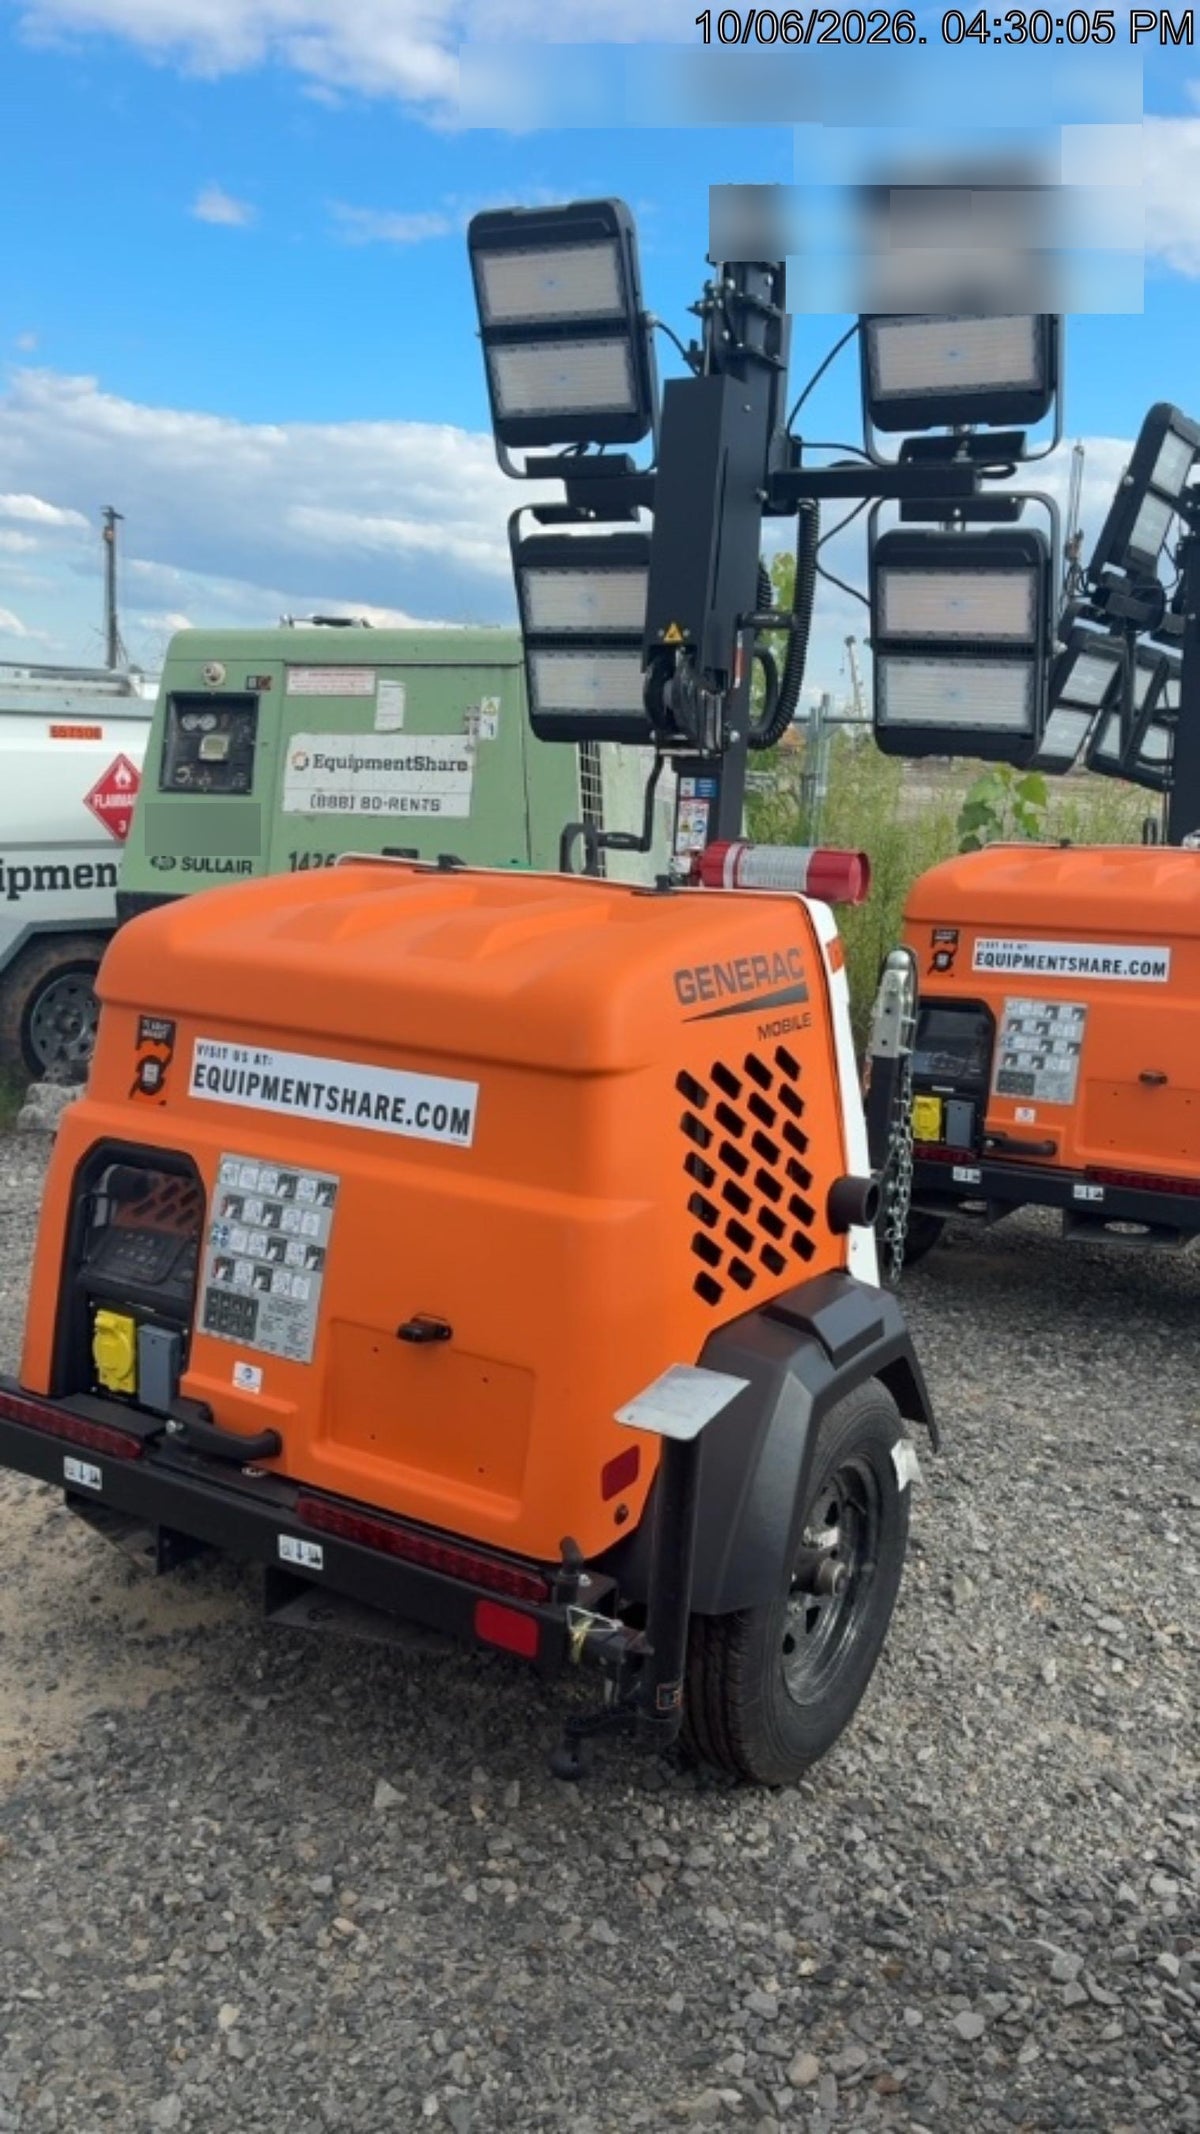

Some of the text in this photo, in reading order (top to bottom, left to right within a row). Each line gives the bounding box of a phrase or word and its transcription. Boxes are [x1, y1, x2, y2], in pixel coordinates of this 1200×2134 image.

[312, 753, 469, 773] EquipmentShare
[310, 794, 441, 812] (888) 80-RENTS
[118, 819, 127, 833] 3
[181, 856, 253, 874] SULLAIR
[974, 951, 1166, 977] EQUIPMENTSHARE.COM
[673, 946, 806, 1006] GENERAC
[757, 1011, 812, 1041] MOBILE
[197, 1043, 274, 1066] VISIT US AT:
[193, 1063, 471, 1136] EQUIPMENTSHARE.COM
